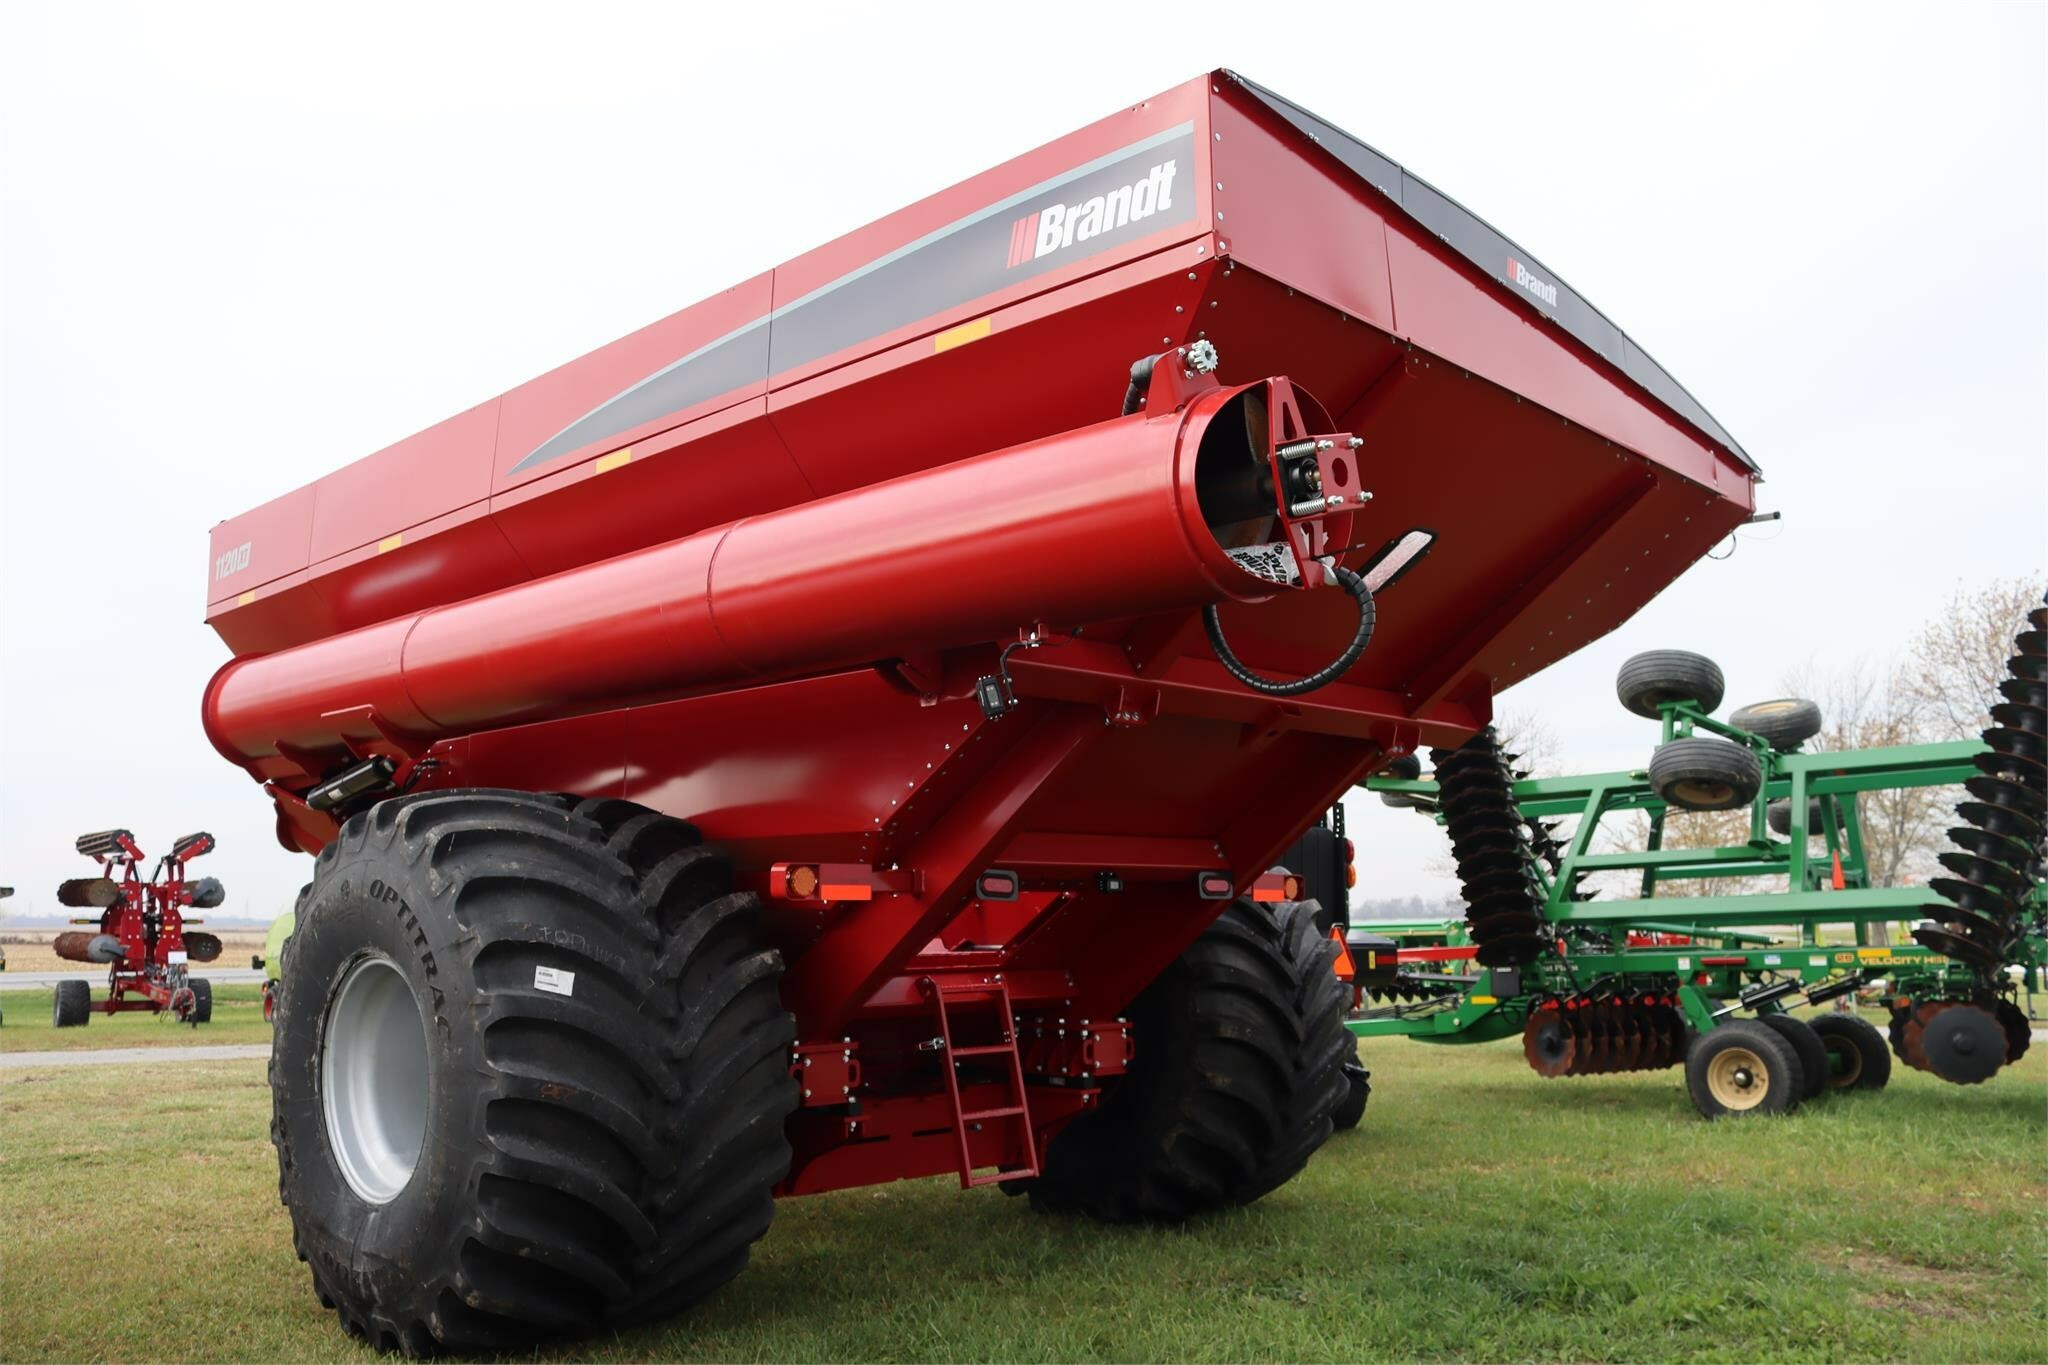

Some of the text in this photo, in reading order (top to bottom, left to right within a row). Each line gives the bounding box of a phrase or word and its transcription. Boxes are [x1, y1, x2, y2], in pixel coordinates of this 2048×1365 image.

[1034, 159, 1176, 258] Brandt
[1516, 262, 1557, 307] Brandt
[369, 879, 452, 1041] OPTITRAC
[1859, 956, 1921, 966] VELOCITY
